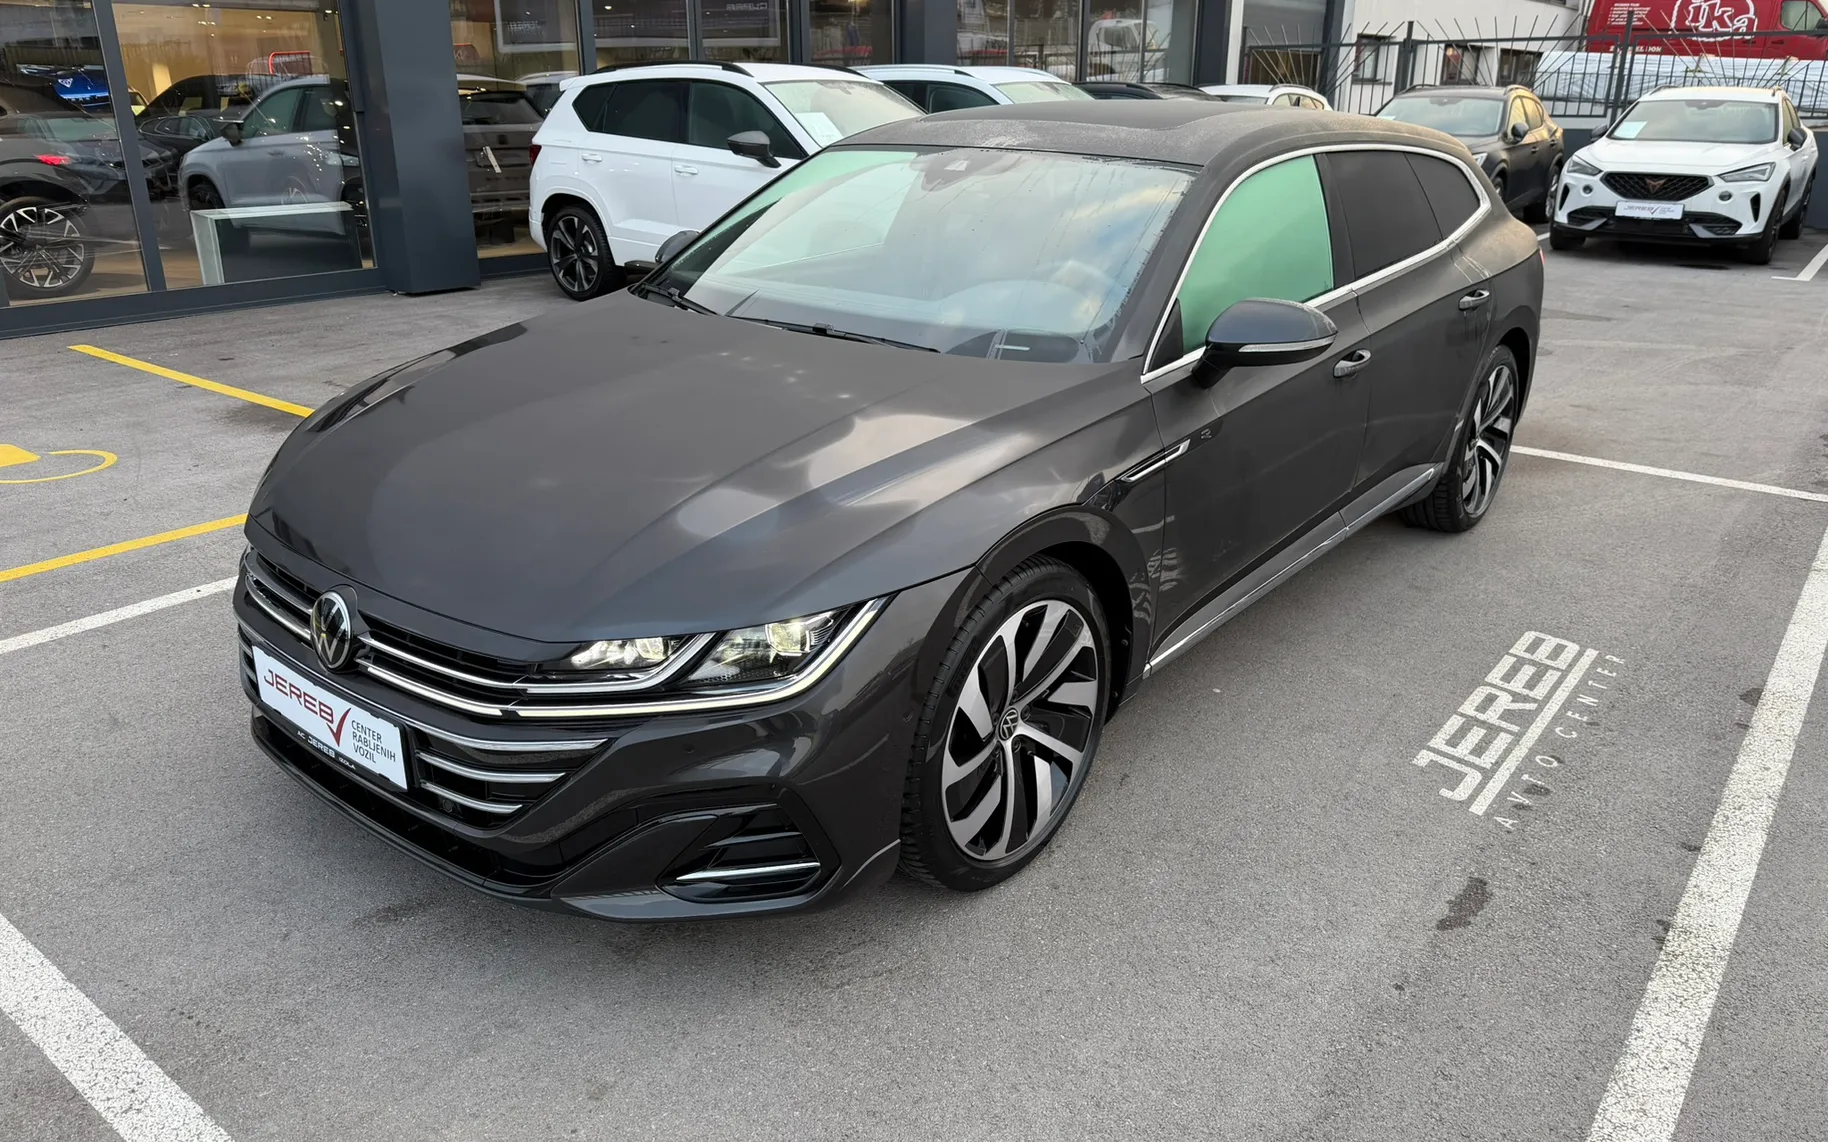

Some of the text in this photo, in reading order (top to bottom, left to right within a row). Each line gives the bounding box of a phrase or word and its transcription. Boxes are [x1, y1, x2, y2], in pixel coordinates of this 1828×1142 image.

[263, 669, 334, 724] JEREB
[351, 719, 382, 744] CENTER
[1411, 631, 1580, 801] JEREB
[297, 730, 306, 740] AC
[307, 736, 335, 758] JEREB
[352, 731, 396, 763] RABLJENIH
[353, 743, 377, 764] VOZIL
[1494, 655, 1626, 829] AVTO CENTER
